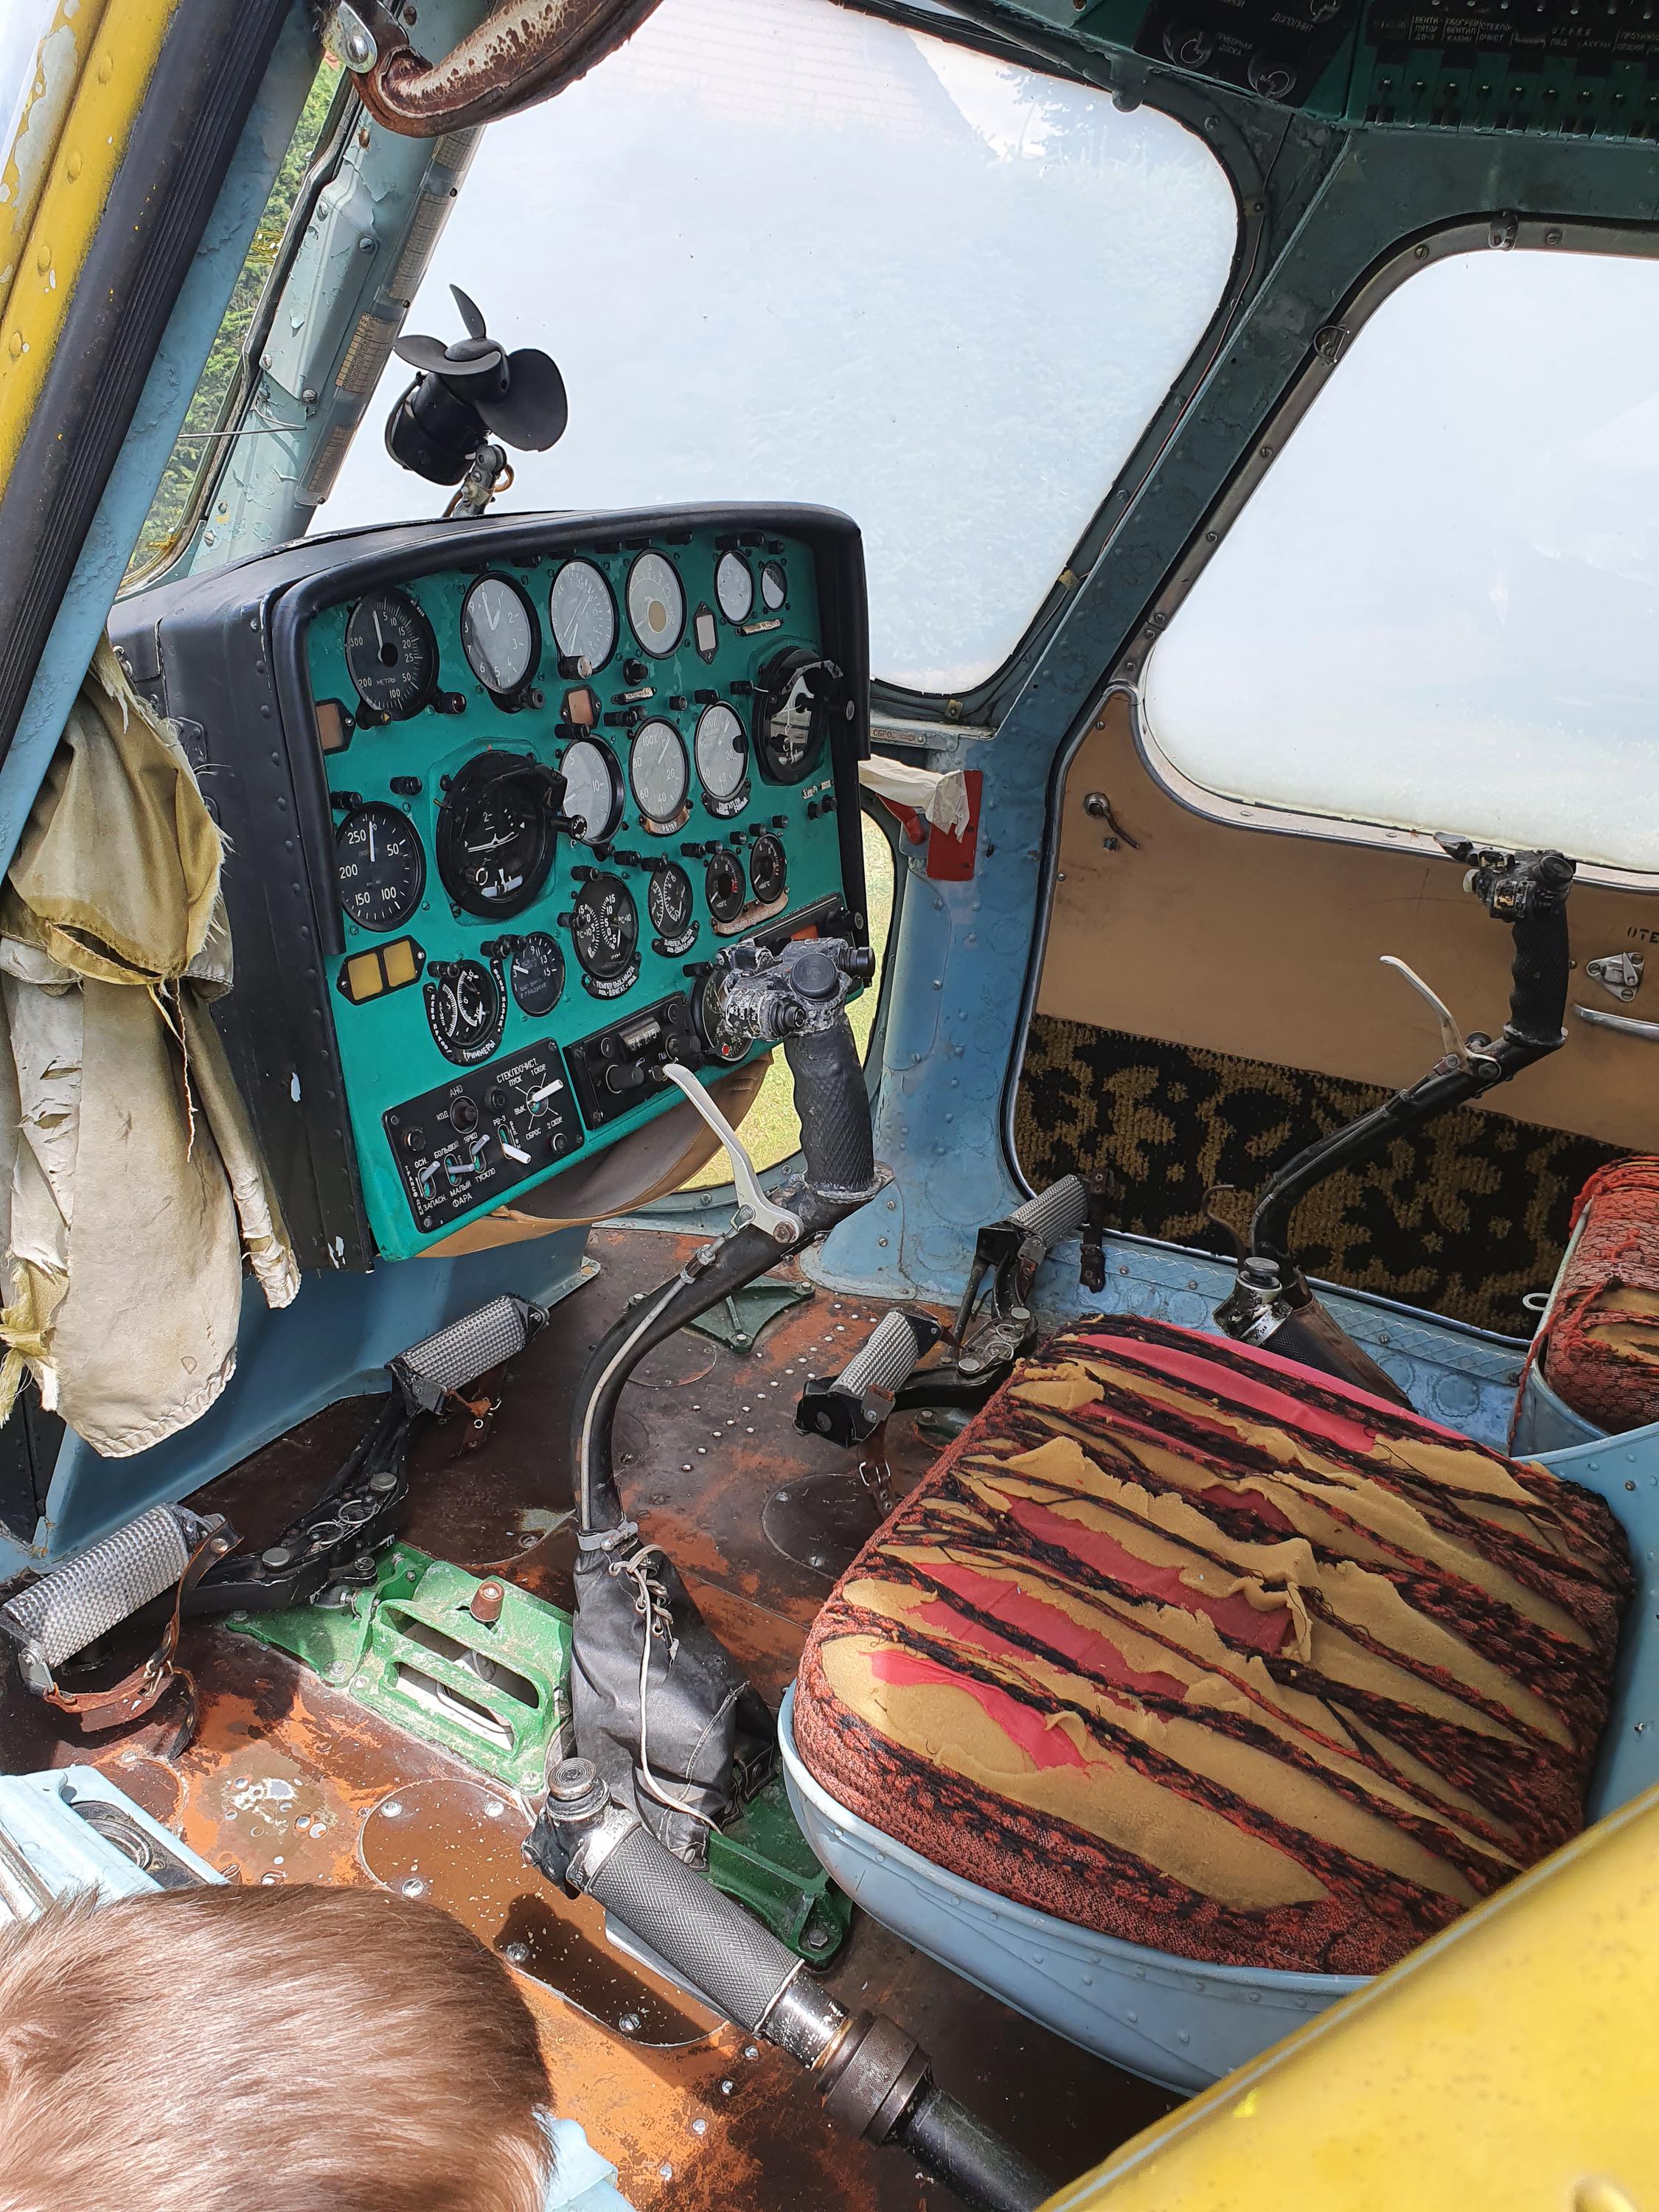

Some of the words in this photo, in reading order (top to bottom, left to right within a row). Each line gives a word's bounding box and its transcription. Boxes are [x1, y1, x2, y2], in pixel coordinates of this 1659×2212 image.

[383, 611, 389, 621] 5
[389, 618, 397, 626] 10
[507, 612, 515, 625] 2
[398, 627, 406, 636] 15
[349, 636, 364, 647] 300
[402, 639, 411, 650] 20
[405, 653, 414, 663] 25
[480, 662, 486, 674] 6
[494, 666, 501, 678] 5
[358, 677, 372, 689] 200
[402, 672, 411, 683] 50
[389, 689, 401, 699] 100
[666, 768, 675, 781] 20
[639, 787, 650, 799] 60
[658, 793, 667, 804] 40
[661, 821, 678, 832] РОТОР
[347, 829, 366, 845] 250
[386, 844, 400, 857] 50
[338, 863, 358, 879] 200
[355, 891, 371, 906] 150
[381, 886, 397, 901] 100
[609, 894, 616, 904] 15
[606, 905, 613, 915] 10
[530, 945, 535, 955] 9
[540, 955, 548, 964] 13
[543, 967, 551, 976] 15
[462, 1039, 496, 1062] ТРИММЕРЫ
[496, 1057, 539, 1083] СТЕКЛООЧИСТ.
[508, 1074, 523, 1087] ПУСК
[450, 1085, 463, 1097] АНО
[436, 1110, 450, 1121] КОД
[493, 1115, 507, 1126] РВ-3
[463, 1132, 479, 1144] ЯРКО
[526, 1127, 542, 1141] СБРОС
[414, 1157, 429, 1169] ОСН.
[475, 1167, 496, 1183] ТУСКЛО
[449, 1180, 472, 1197] МАЛЫЙ
[422, 1194, 448, 1212] ЗАПАСН.
[452, 1192, 473, 1208] ФАРА
